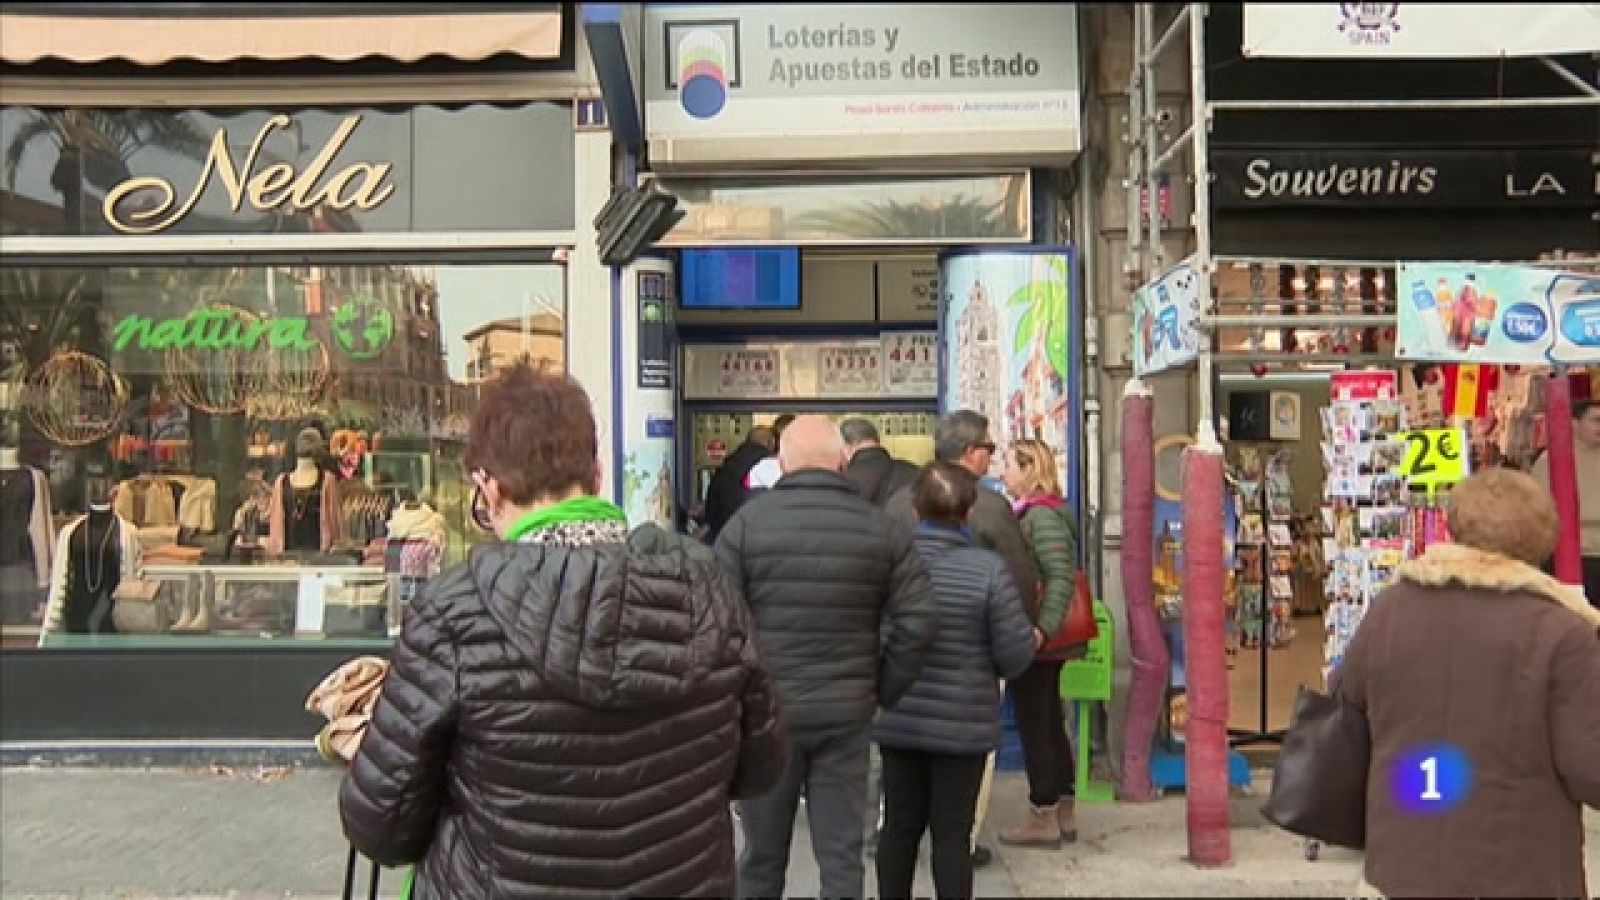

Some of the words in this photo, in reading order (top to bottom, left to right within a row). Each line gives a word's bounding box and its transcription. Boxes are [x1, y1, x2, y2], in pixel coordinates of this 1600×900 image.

[884, 27, 899, 53] y
[769, 57, 891, 88] Apuestas
[902, 54, 940, 79] del
[949, 52, 1040, 79] Estado
[103, 114, 395, 233] Nela
[1244, 159, 1438, 198] Souvenirs
[1505, 172, 1566, 197] LA
[113, 310, 321, 352] natura
[1405, 431, 1460, 476] 2€
